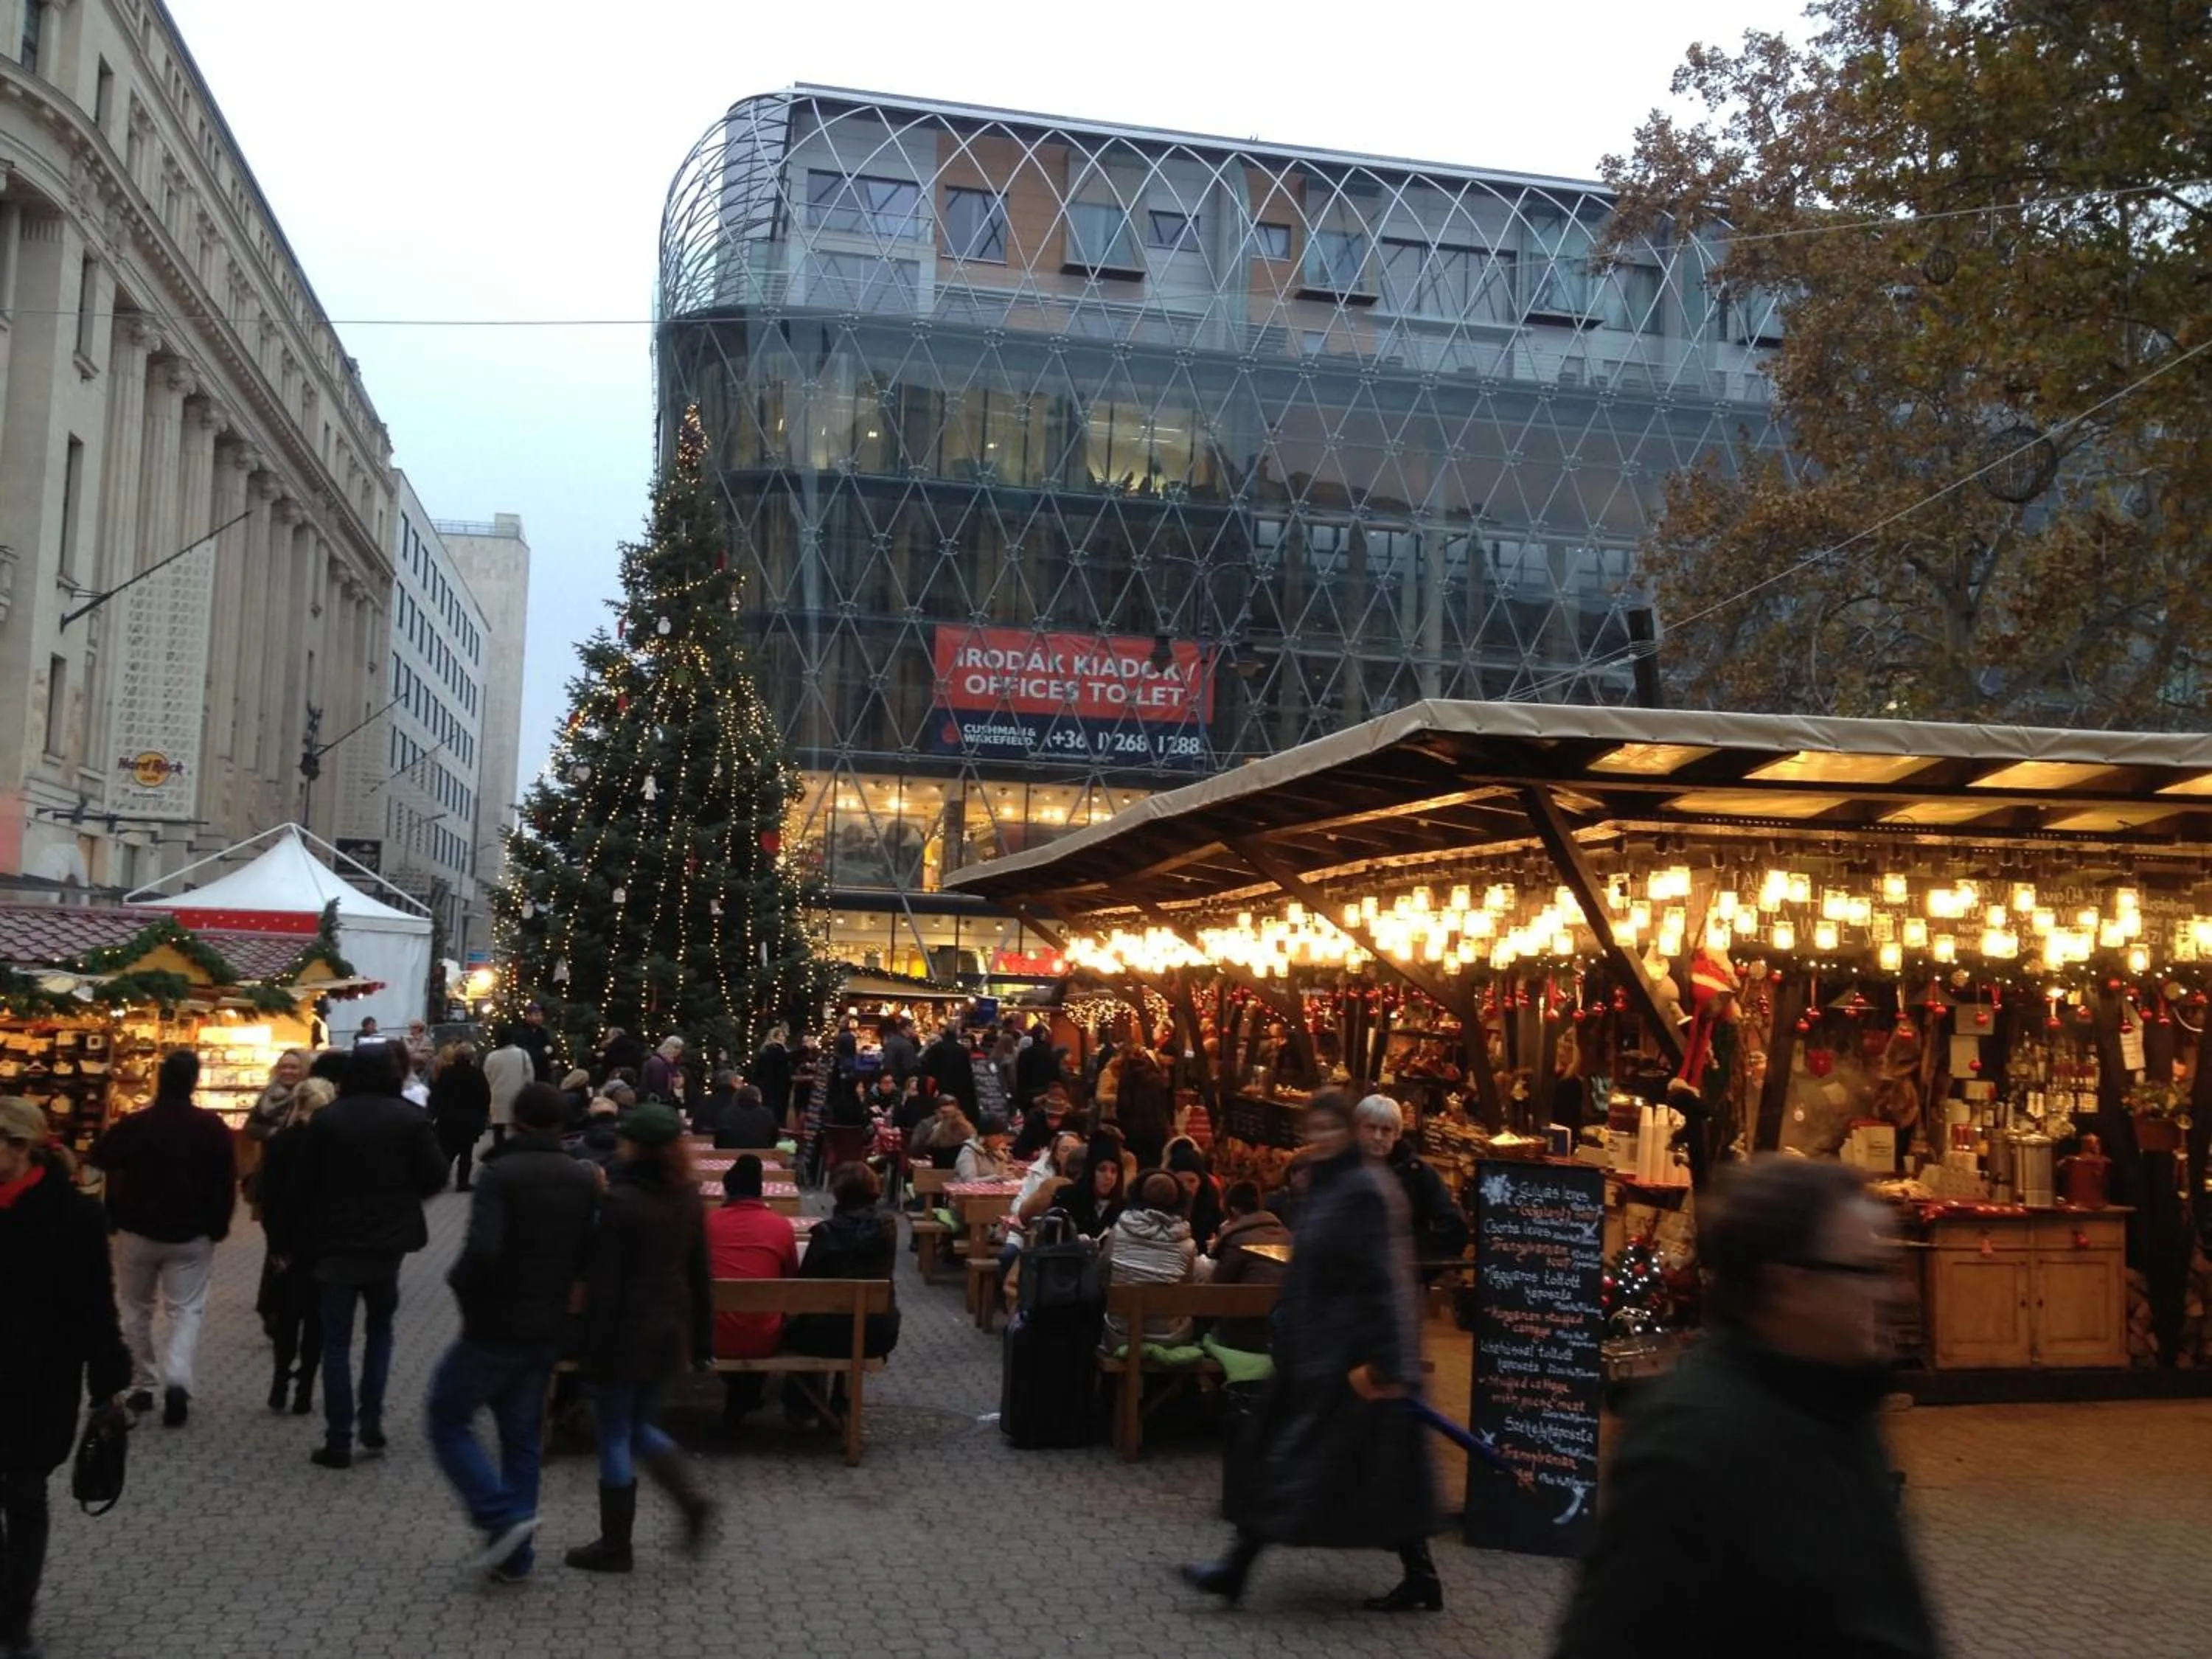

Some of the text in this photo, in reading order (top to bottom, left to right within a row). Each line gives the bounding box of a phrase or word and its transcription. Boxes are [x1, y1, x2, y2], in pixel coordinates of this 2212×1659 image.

[956, 647, 1065, 675] IRODÁK
[964, 675, 1185, 706] OFFICES TO LET
[1114, 734, 1149, 753] 268
[1158, 736, 1200, 755] 1288
